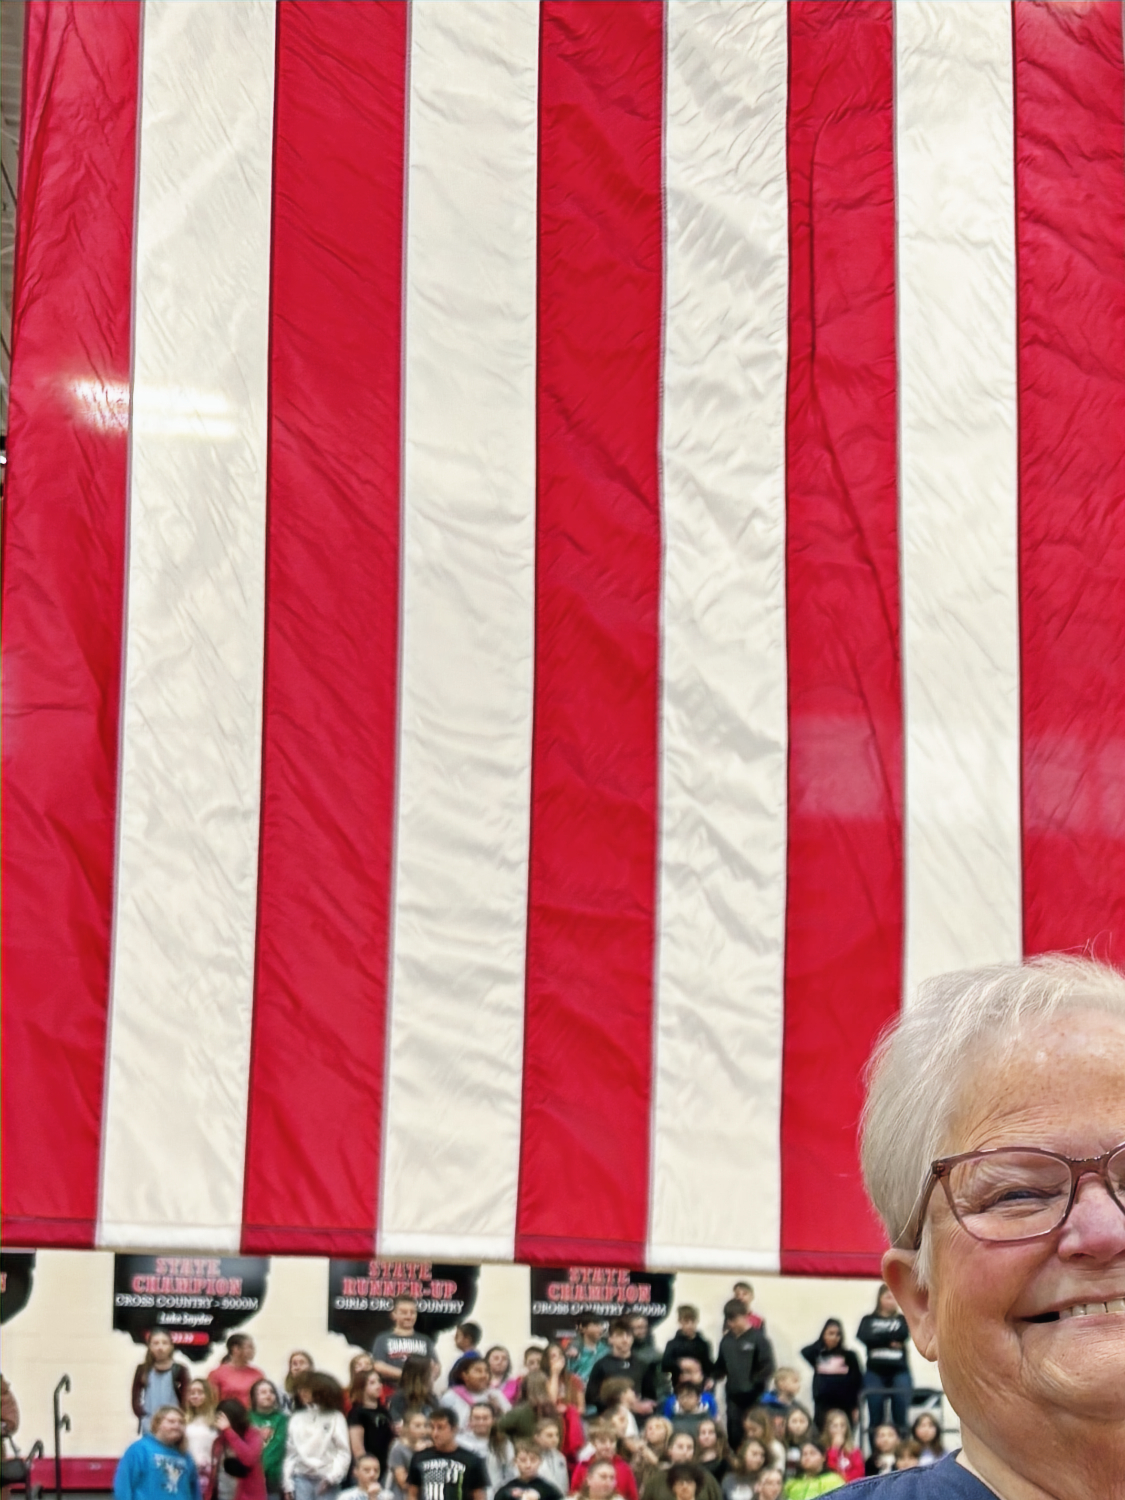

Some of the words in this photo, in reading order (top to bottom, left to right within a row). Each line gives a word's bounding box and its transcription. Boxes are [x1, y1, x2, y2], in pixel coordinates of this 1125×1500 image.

[155, 1257, 221, 1276] STATE
[368, 1260, 432, 1281] STATE
[568, 1265, 631, 1285] STATE
[131, 1274, 243, 1297] CHAMPION
[342, 1277, 458, 1300] RUNNER-UP
[546, 1282, 652, 1304] CHAMPION
[115, 1293, 154, 1308] CROSS
[156, 1294, 214, 1310] COUNTRY
[334, 1297, 368, 1311] GIRLS
[370, 1299, 396, 1313] CRO
[415, 1300, 465, 1315] OUNTRY
[532, 1301, 569, 1315] CROSS
